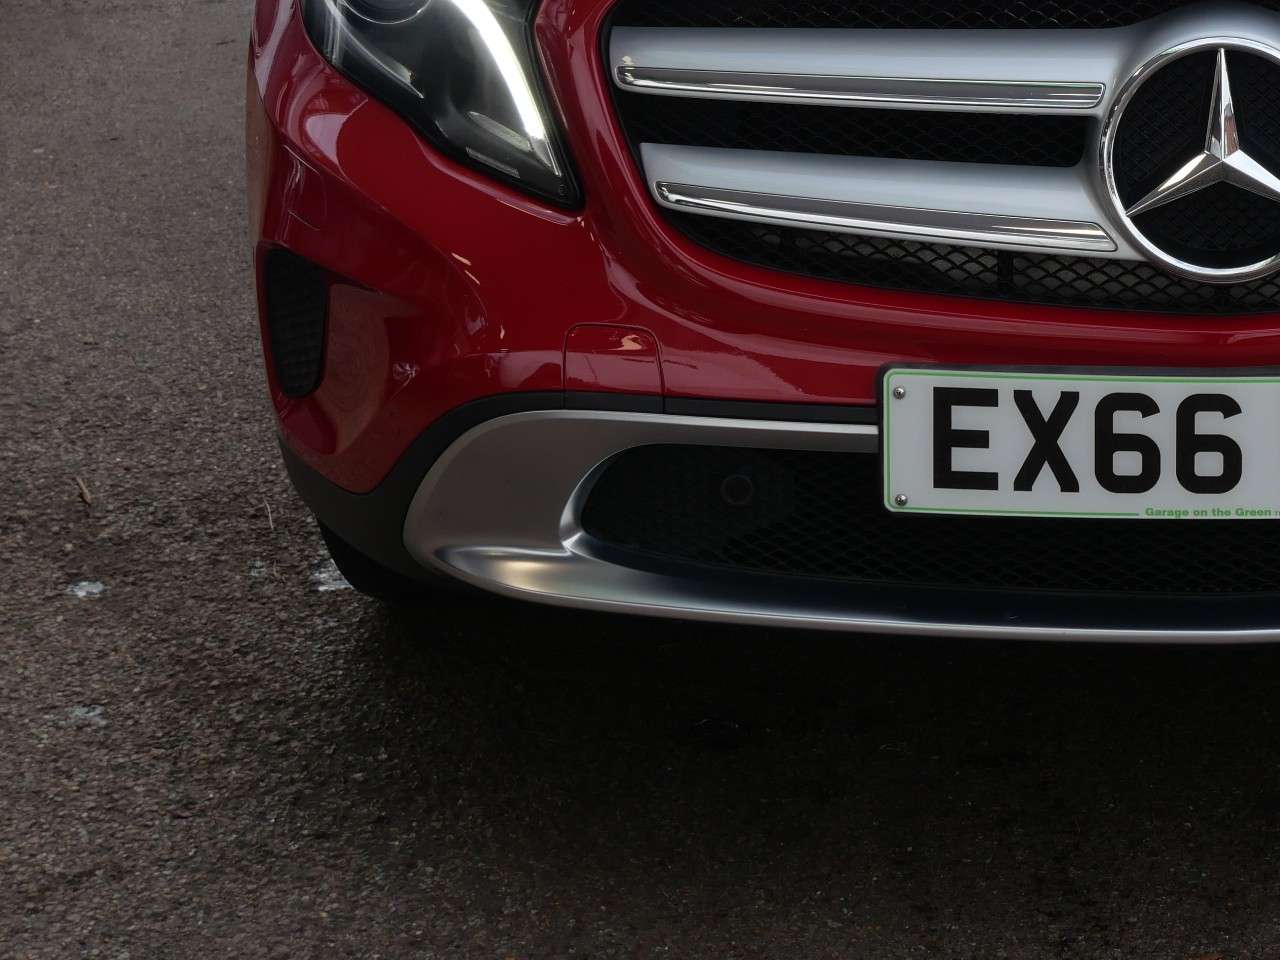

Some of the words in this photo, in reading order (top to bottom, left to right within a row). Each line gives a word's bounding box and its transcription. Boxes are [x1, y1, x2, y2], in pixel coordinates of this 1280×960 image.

[932, 386, 1243, 495] EX66
[1145, 507, 1190, 518] Garage
[1193, 509, 1208, 517] on
[1211, 507, 1232, 517] the
[1235, 507, 1272, 517] Green
